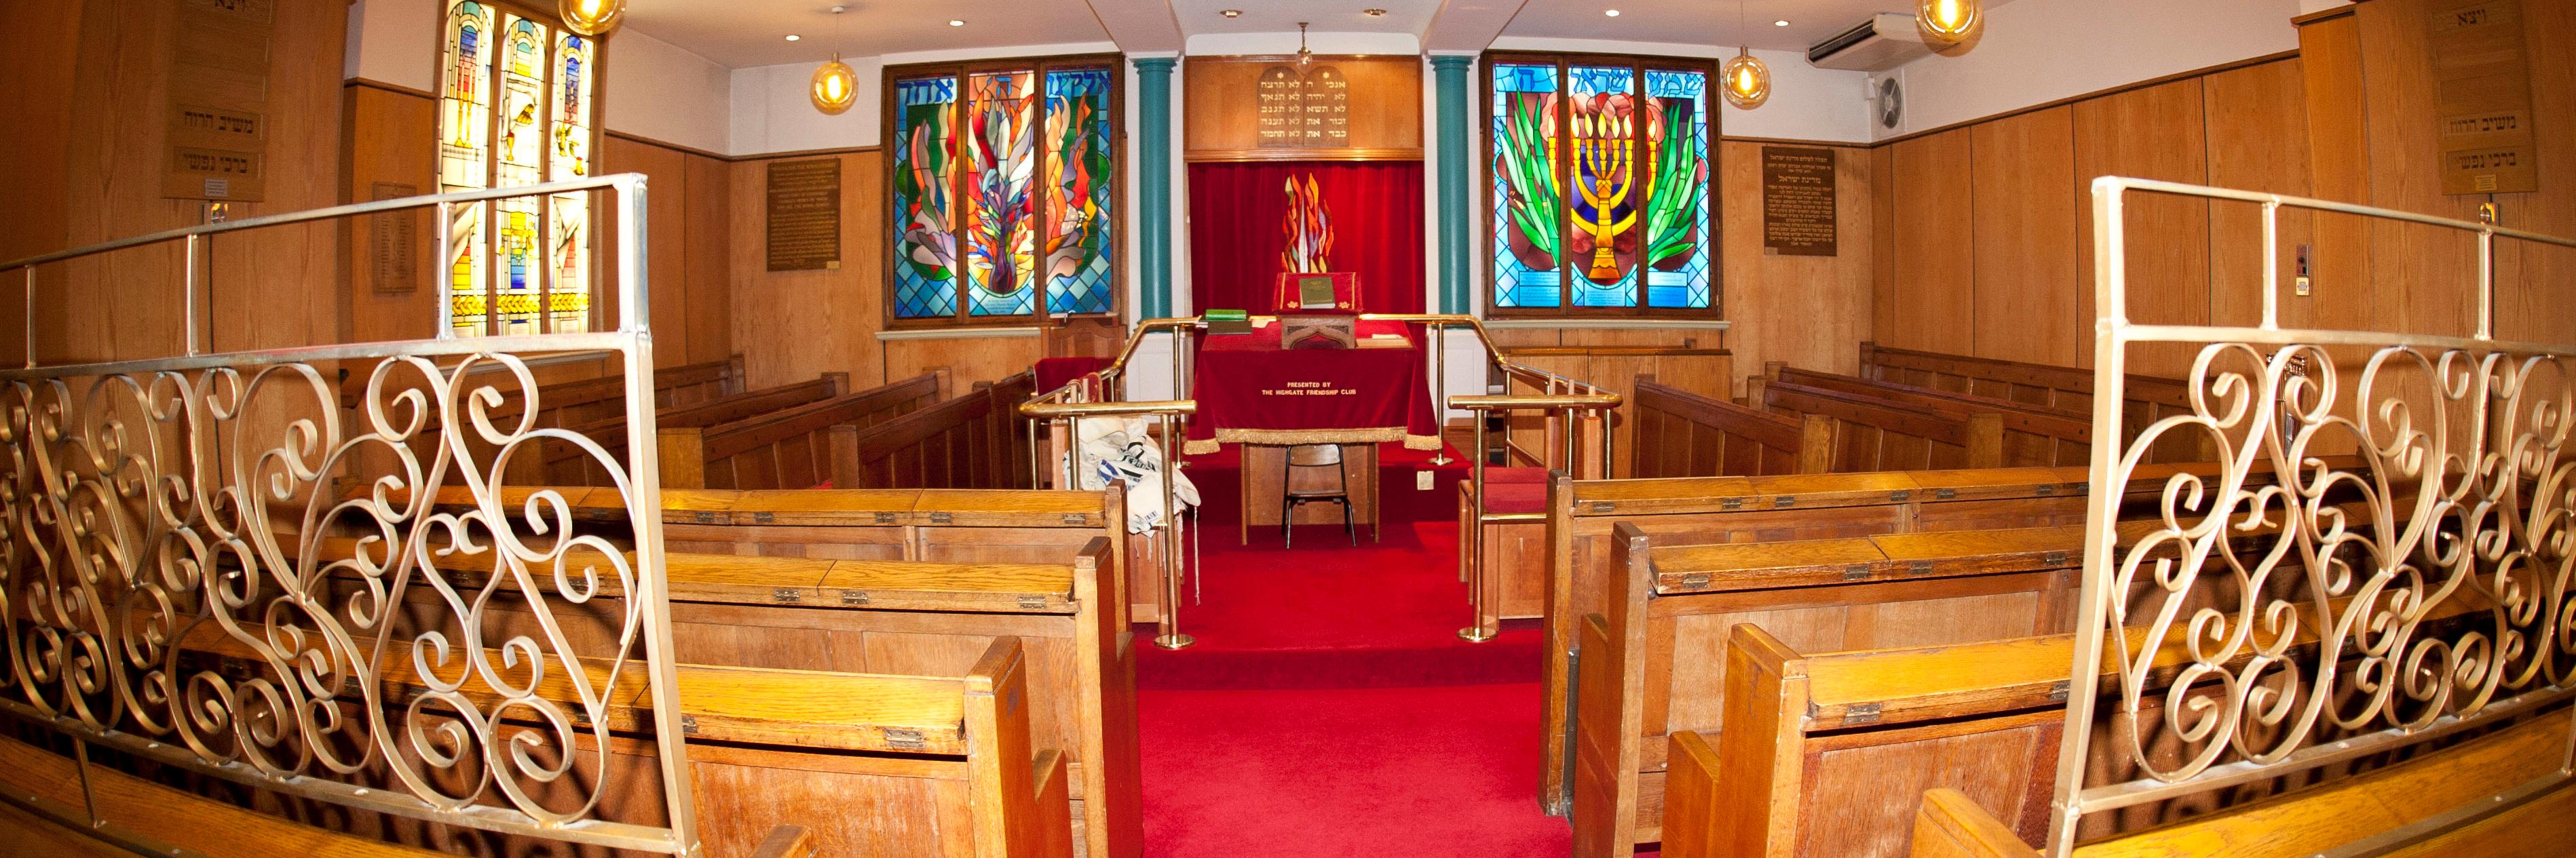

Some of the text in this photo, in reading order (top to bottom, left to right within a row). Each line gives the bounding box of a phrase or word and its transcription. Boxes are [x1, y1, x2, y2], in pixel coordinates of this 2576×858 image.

[2457, 9, 2486, 26] ויצא
[1289, 79, 1300, 88] לא
[1570, 64, 1634, 95] ישראל
[1646, 72, 1705, 99] שמע
[896, 79, 953, 104] אחד
[1261, 92, 1300, 102] לא תנאף
[1335, 92, 1346, 100] לא
[1289, 104, 1300, 113] לא
[1335, 104, 1346, 113] לא
[184, 111, 253, 134] משיב הרוח
[1289, 117, 1300, 125] לא
[2450, 115, 2516, 134] משיב הרוח
[1289, 129, 1300, 137] לא
[183, 153, 248, 174] ברכי נפשי
[2488, 152, 2517, 167] ברכי
[1778, 173, 1800, 182] ישראל
